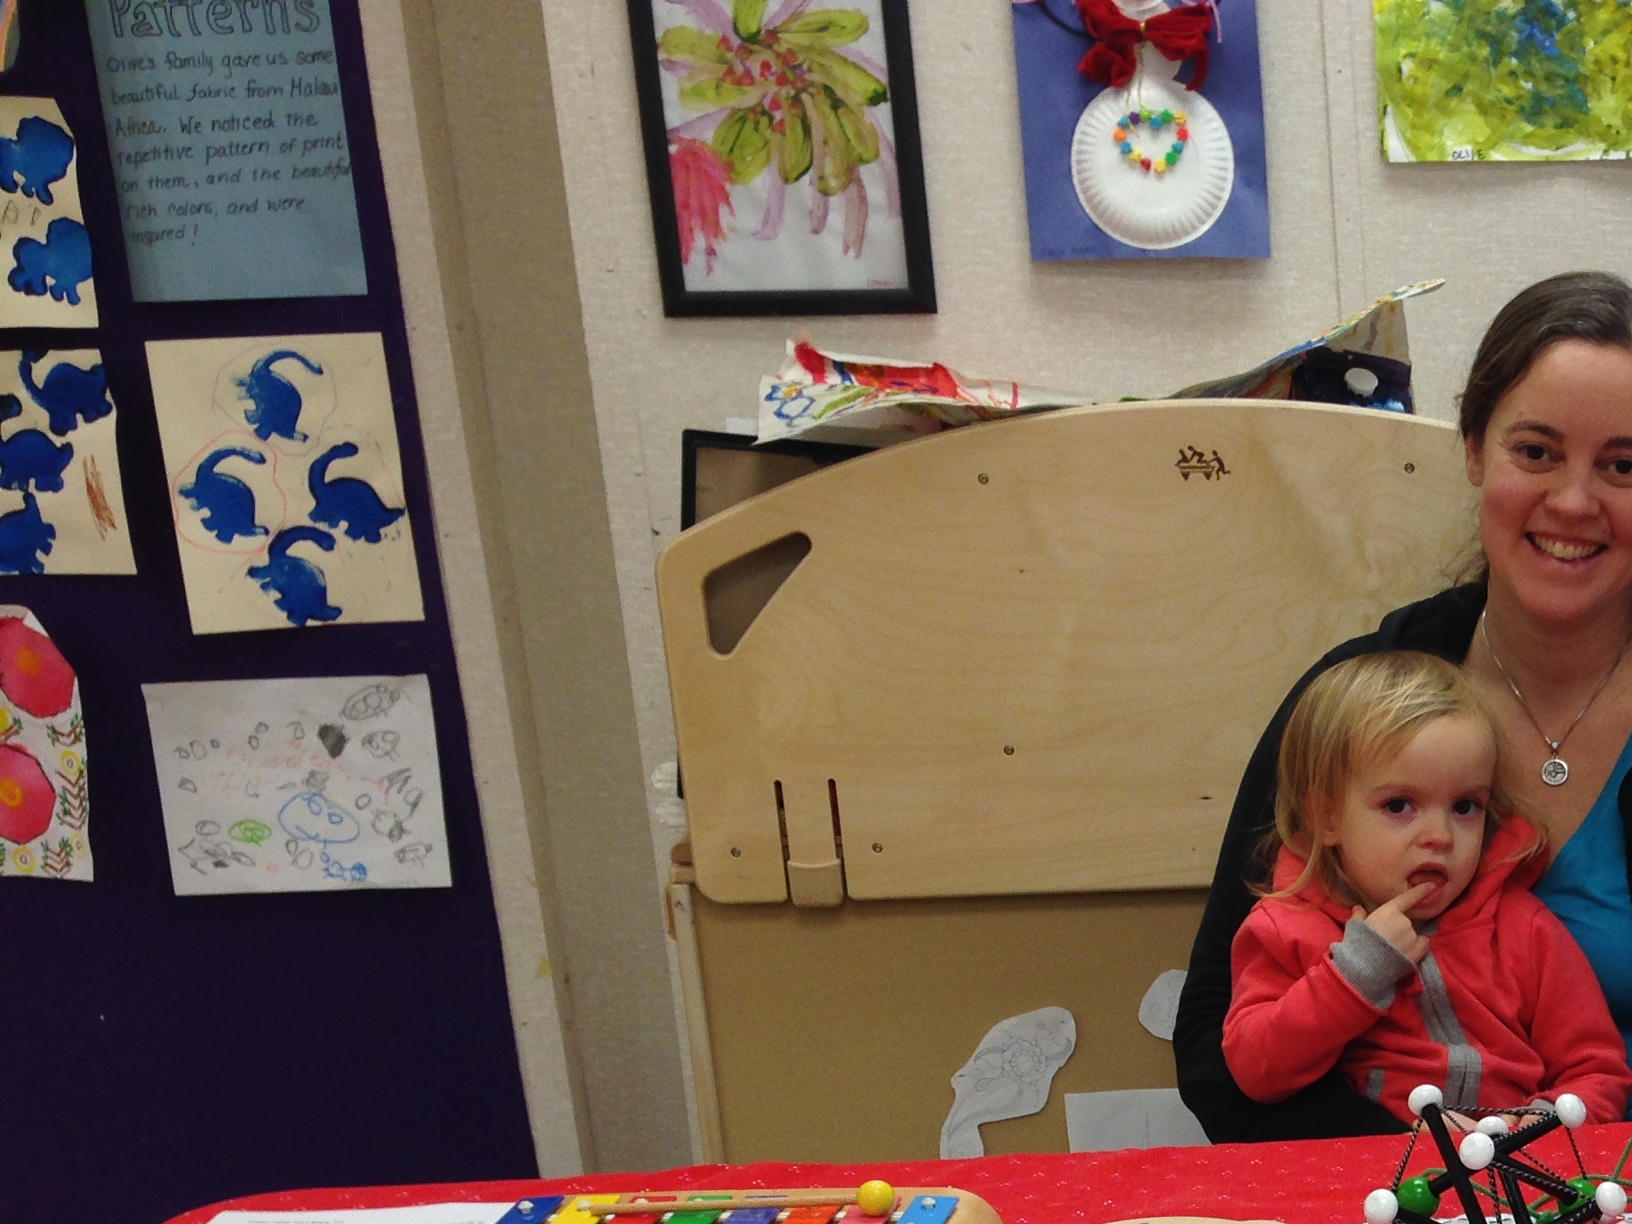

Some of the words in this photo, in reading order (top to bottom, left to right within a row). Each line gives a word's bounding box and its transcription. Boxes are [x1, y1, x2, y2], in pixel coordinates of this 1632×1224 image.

[108, 0, 321, 38] Patterns
[164, 50, 214, 77] family
[222, 53, 261, 79] gave
[266, 51, 288, 66] us
[295, 48, 335, 65] some
[112, 83, 178, 105] beautiful
[185, 82, 236, 102] fabric
[246, 78, 283, 99] from
[179, 115, 202, 135] We
[210, 110, 276, 132] noticed
[285, 112, 319, 128] the
[117, 143, 194, 171] repetitive
[205, 140, 270, 166] pattern
[279, 137, 295, 154] of
[302, 131, 343, 157] print
[120, 179, 139, 194] on
[205, 168, 242, 185] and
[252, 166, 281, 181] the
[126, 203, 158, 219] rich
[227, 198, 259, 214] and
[266, 197, 306, 212] were
